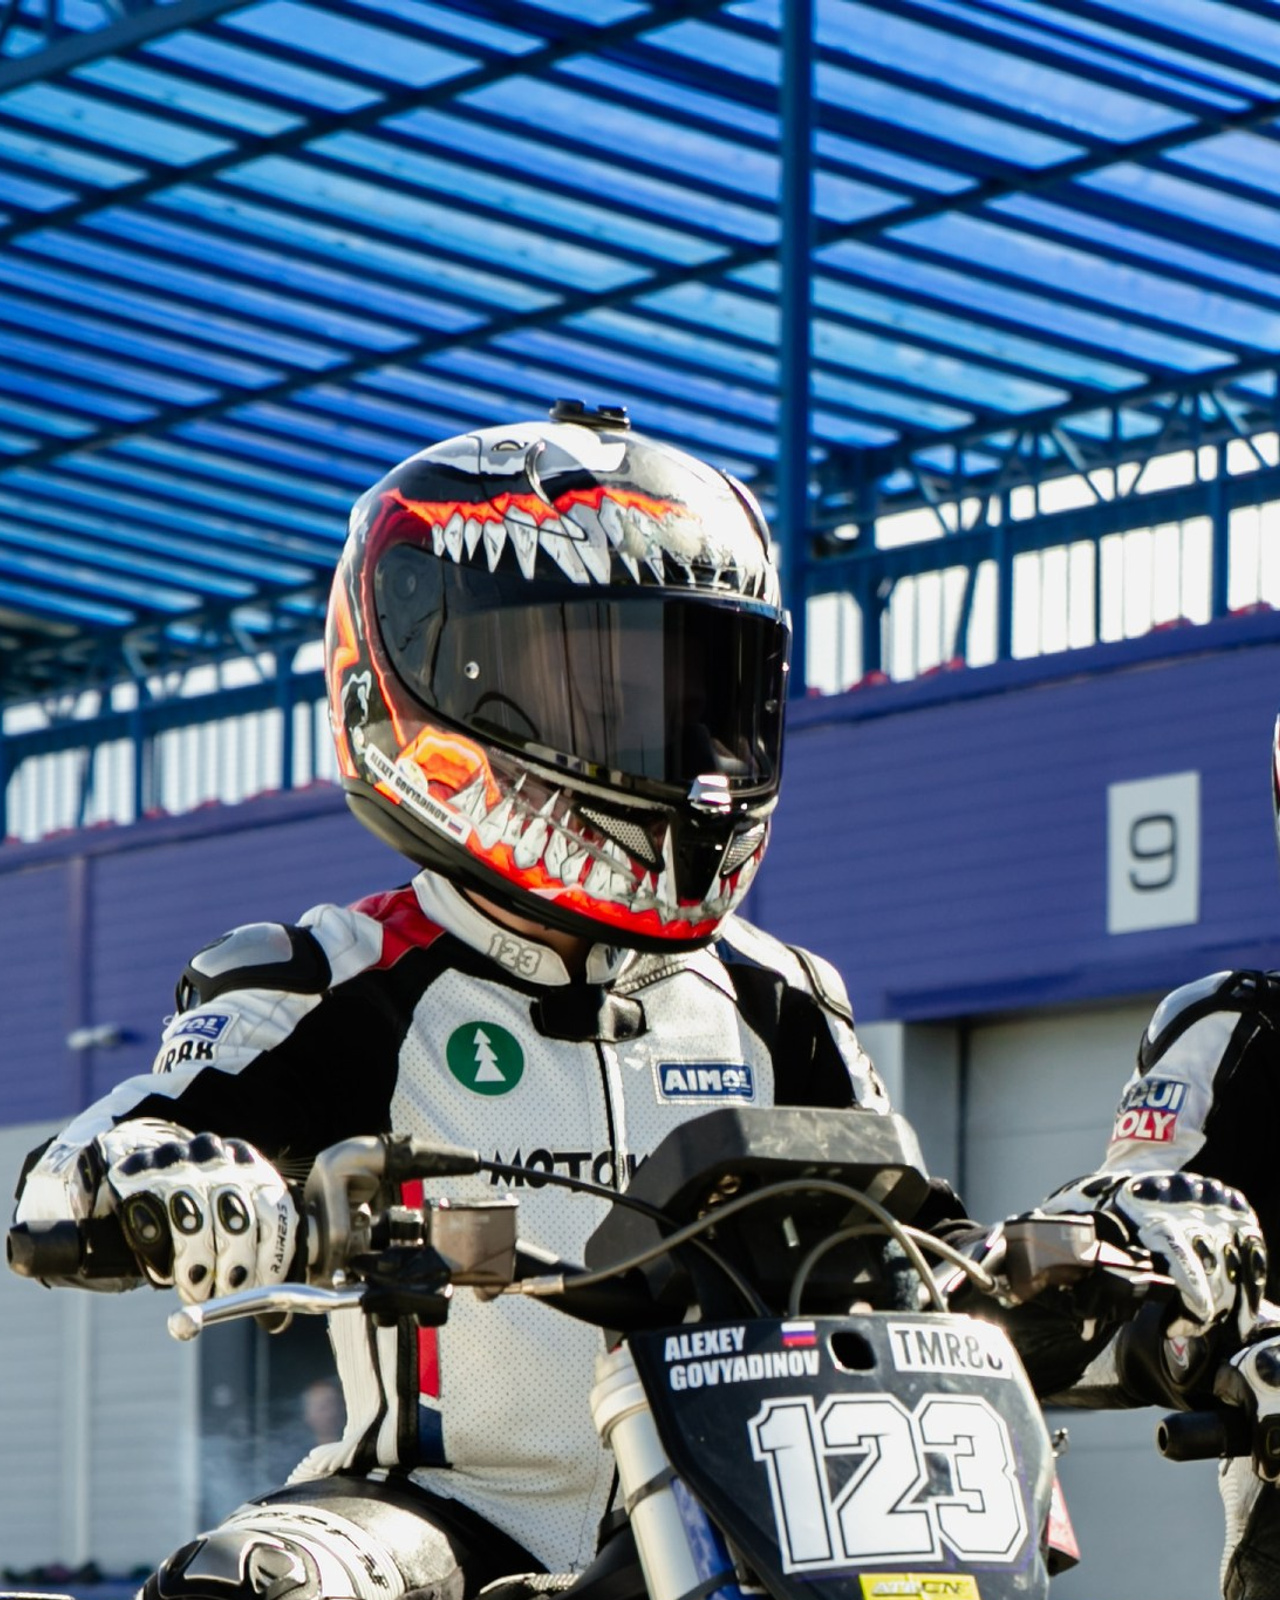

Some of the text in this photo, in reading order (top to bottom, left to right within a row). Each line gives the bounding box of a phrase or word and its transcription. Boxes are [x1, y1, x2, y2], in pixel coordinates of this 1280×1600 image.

[1129, 814, 1178, 893] 9
[486, 933, 543, 976] 123
[664, 1068, 751, 1096] AIMOL
[664, 1327, 746, 1362] ALEXEY
[669, 1350, 820, 1390] GOVYADINOV
[746, 1393, 1029, 1574] 123
